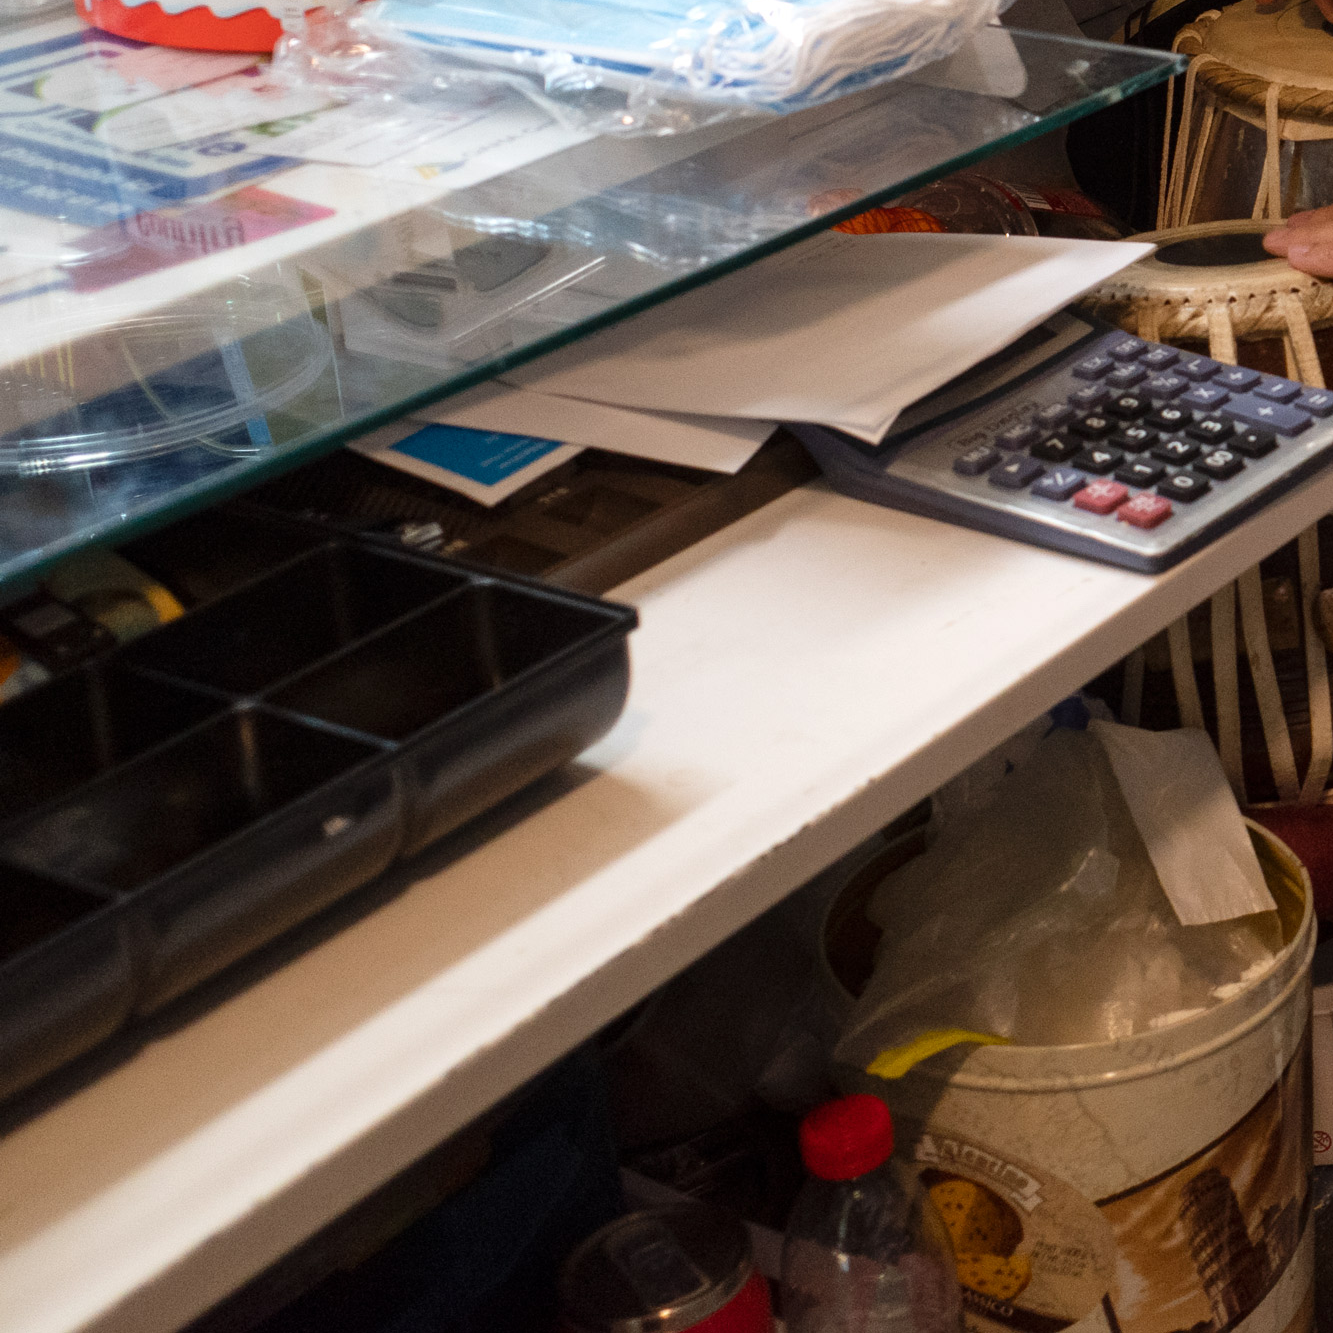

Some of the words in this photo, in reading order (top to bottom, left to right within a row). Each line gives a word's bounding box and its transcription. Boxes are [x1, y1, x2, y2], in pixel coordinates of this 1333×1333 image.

[1161, 408, 1181, 420] 6
[1201, 420, 1222, 432] 3
[1126, 427, 1147, 438] 5
[1046, 438, 1065, 450] 7
[1166, 441, 1190, 453] 2
[1092, 451, 1112, 463] 4
[1133, 464, 1152, 474] 1
[1172, 475, 1194, 488] 0
